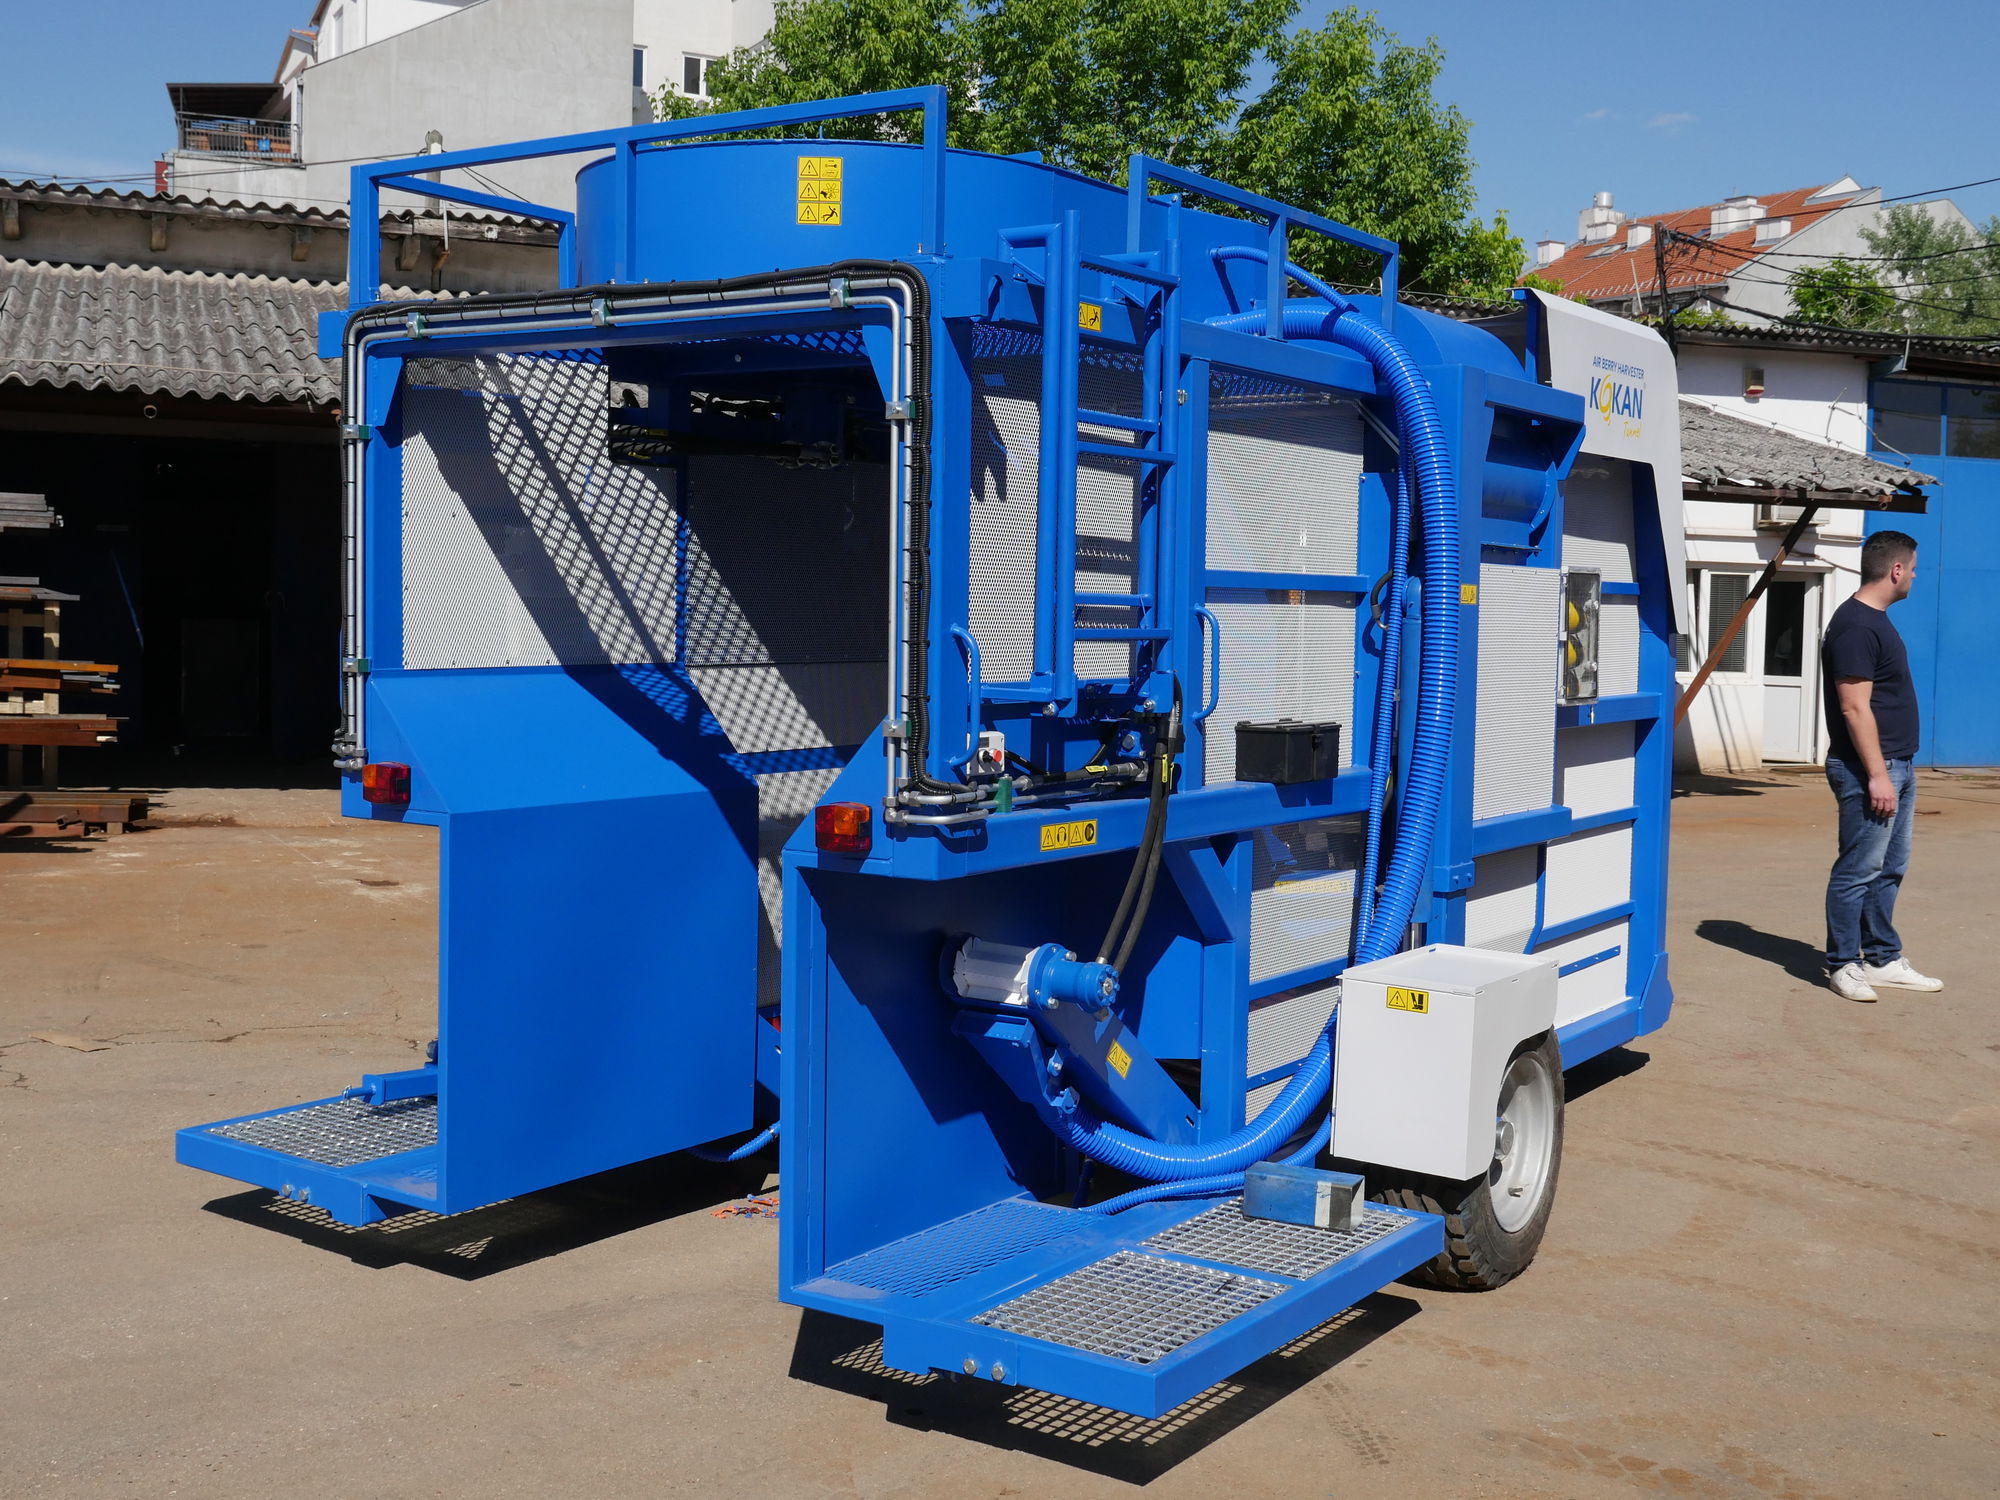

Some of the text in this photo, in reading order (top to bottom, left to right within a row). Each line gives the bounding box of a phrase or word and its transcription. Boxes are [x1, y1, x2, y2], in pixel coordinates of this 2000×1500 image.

[1593, 356, 1645, 380] AIR BERRY HARVESTER
[1589, 374, 1643, 424] KOKAN
